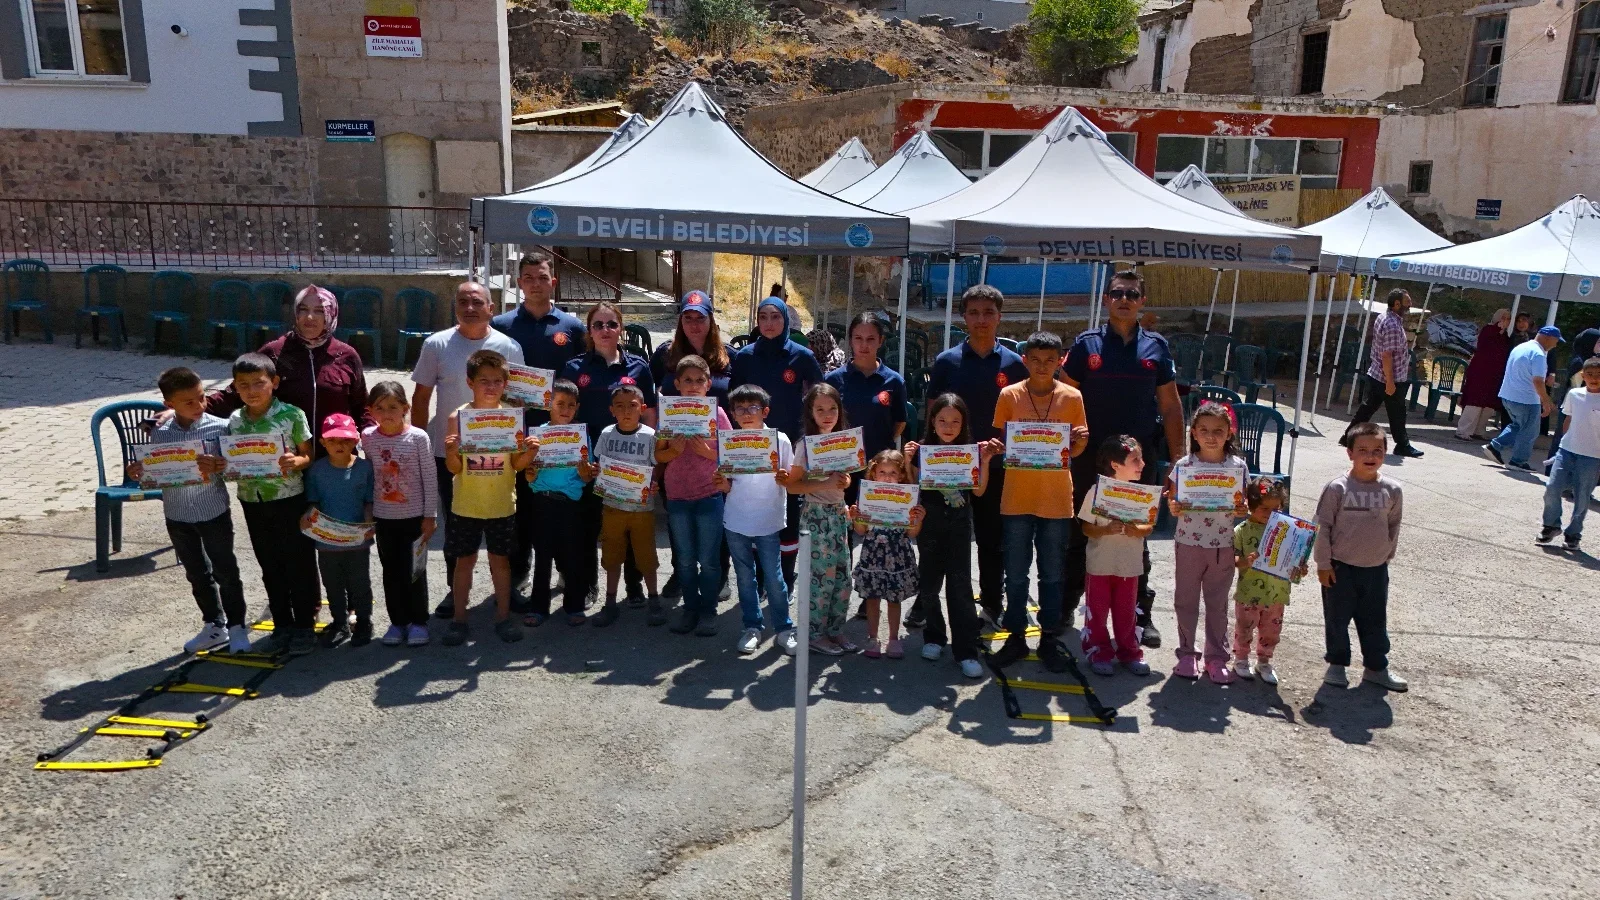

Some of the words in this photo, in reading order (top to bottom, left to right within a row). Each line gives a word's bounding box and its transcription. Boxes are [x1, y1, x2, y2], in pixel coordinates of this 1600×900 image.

[1280, 181, 1294, 192] VE
[577, 213, 664, 241] DEVELİ
[672, 219, 809, 247] BELEDİYESİ
[1039, 235, 1115, 258] DEVELİ
[1122, 238, 1243, 262] BELEDİYESİ
[1445, 266, 1510, 287] BELEDİYESİ
[608, 439, 646, 456] BLACK
